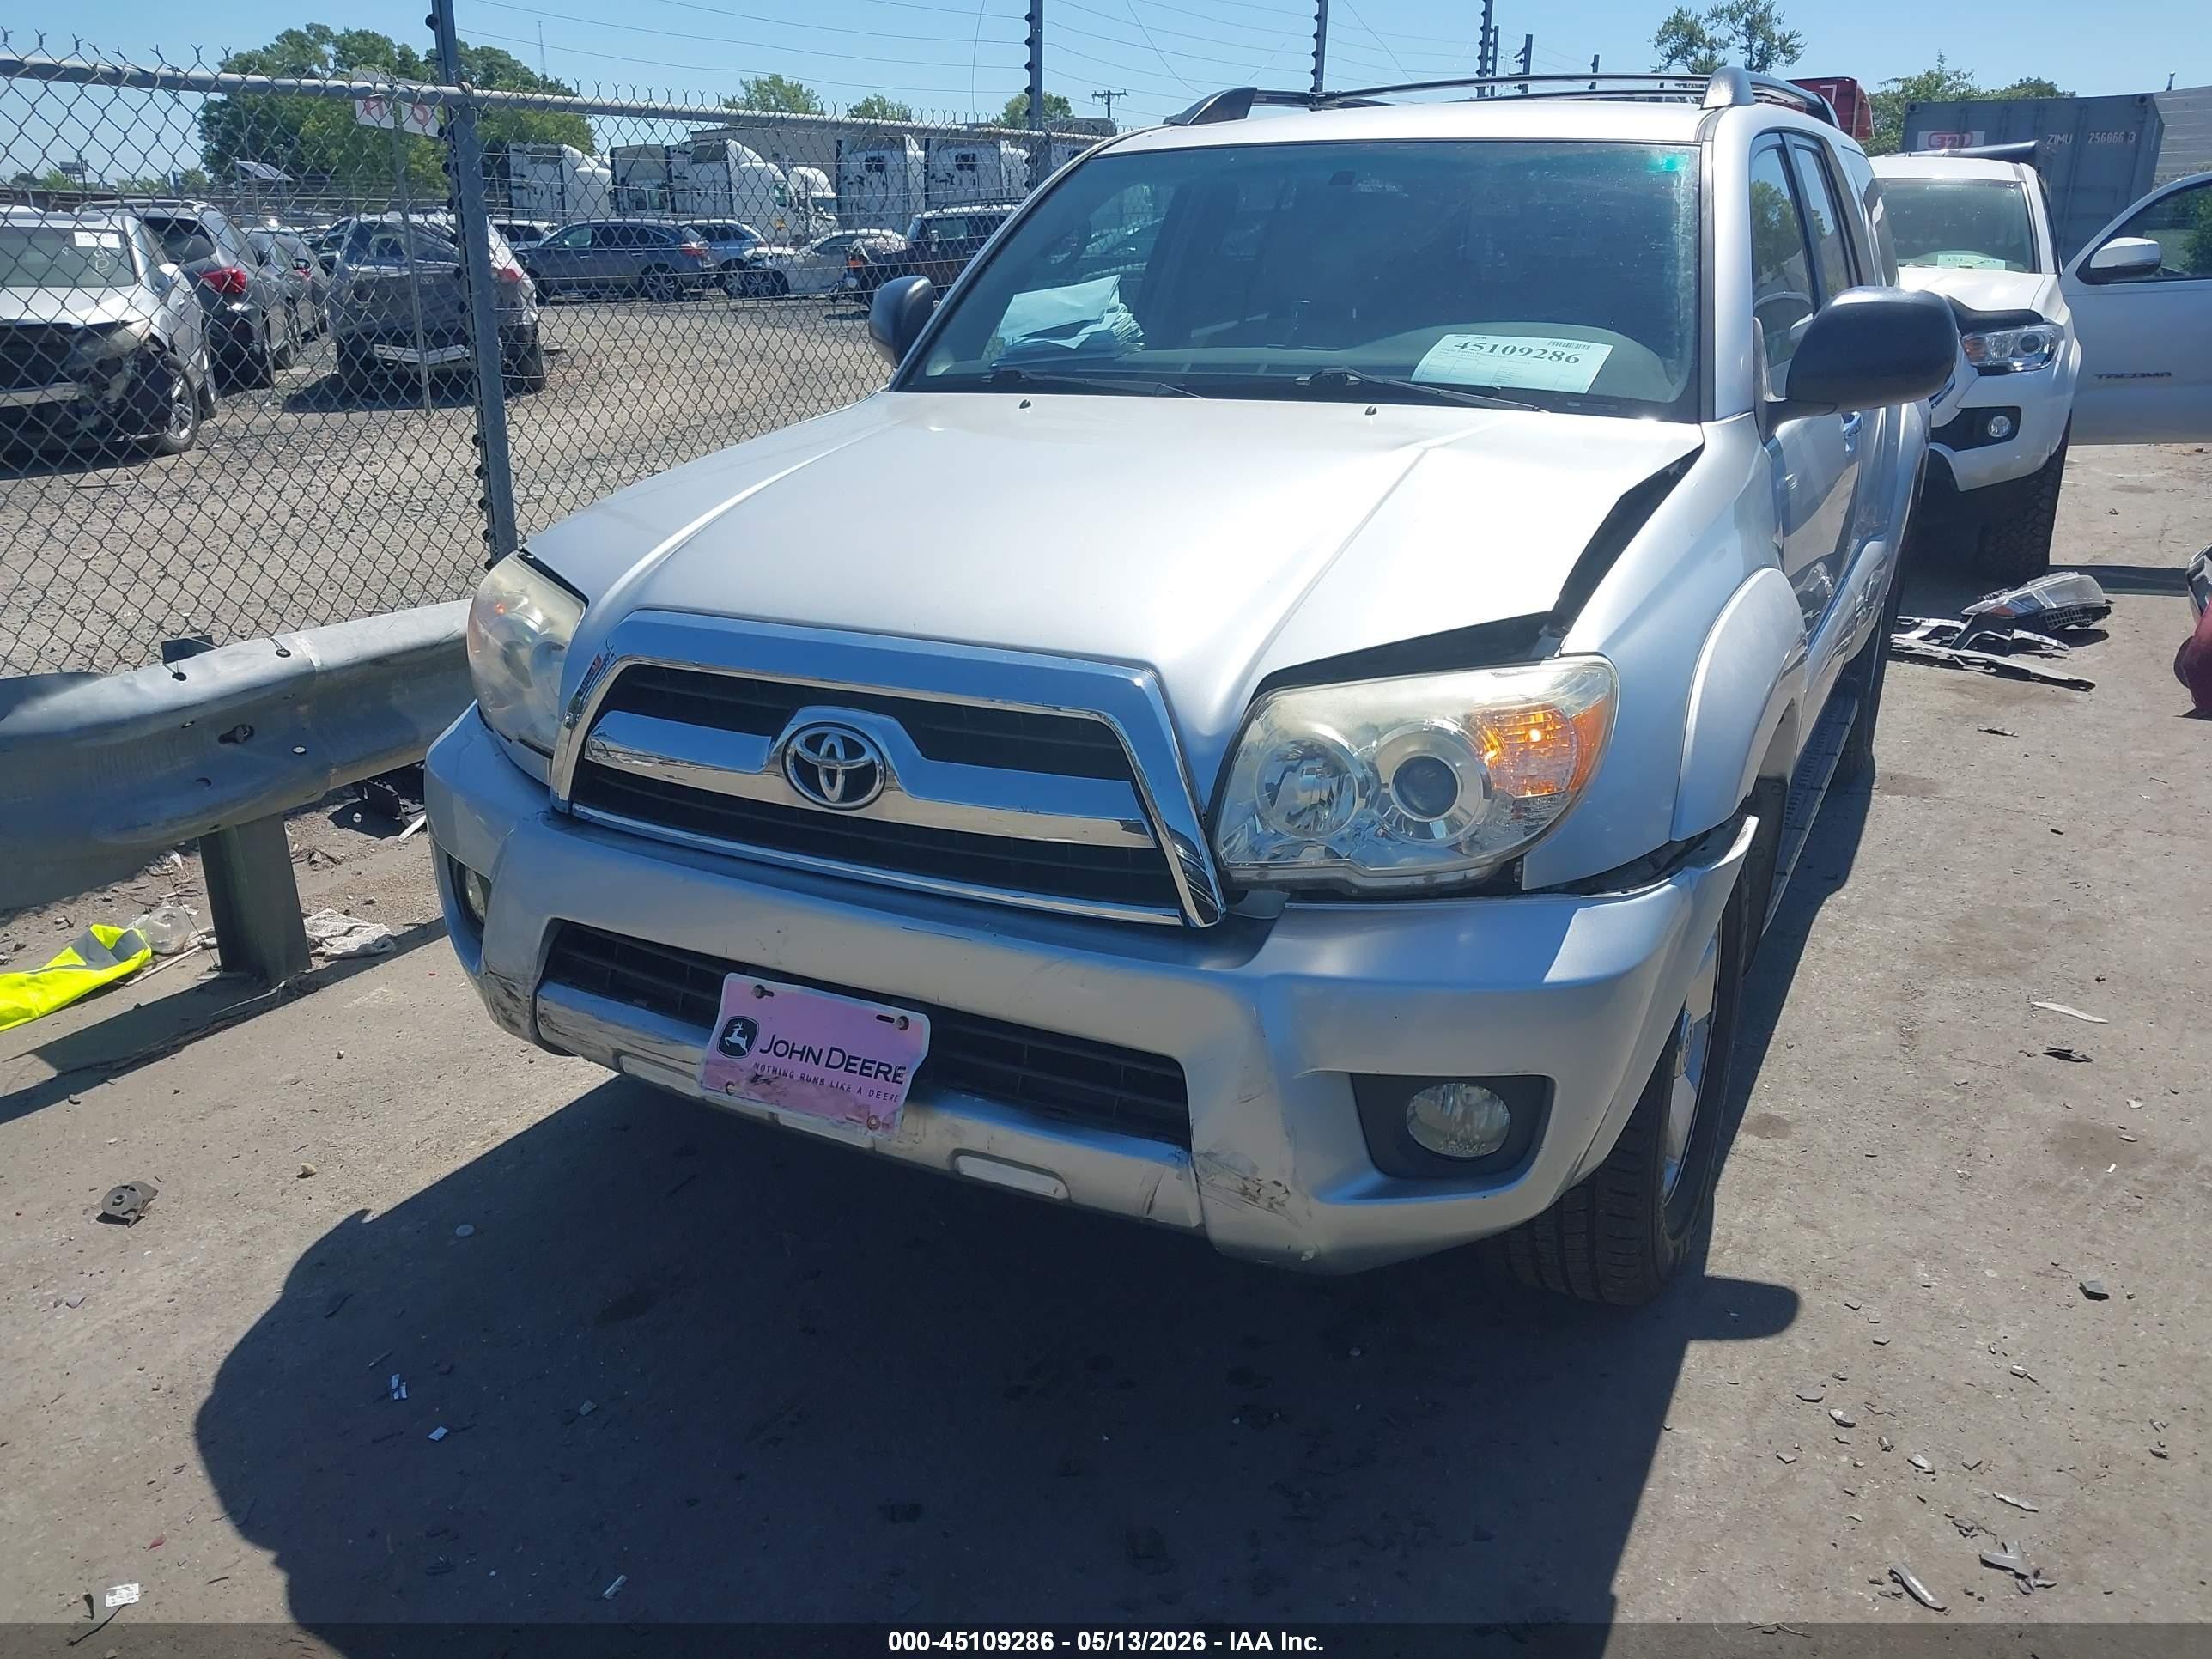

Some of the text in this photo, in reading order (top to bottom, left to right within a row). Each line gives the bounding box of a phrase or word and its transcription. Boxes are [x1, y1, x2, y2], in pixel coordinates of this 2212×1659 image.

[2046, 134, 2074, 144] ZIMU
[1453, 341, 1580, 364] 45109286
[760, 1035, 907, 1085] JOHN DEERE
[754, 1063, 900, 1103] NOTHING RUNS LIKE A DEERE
